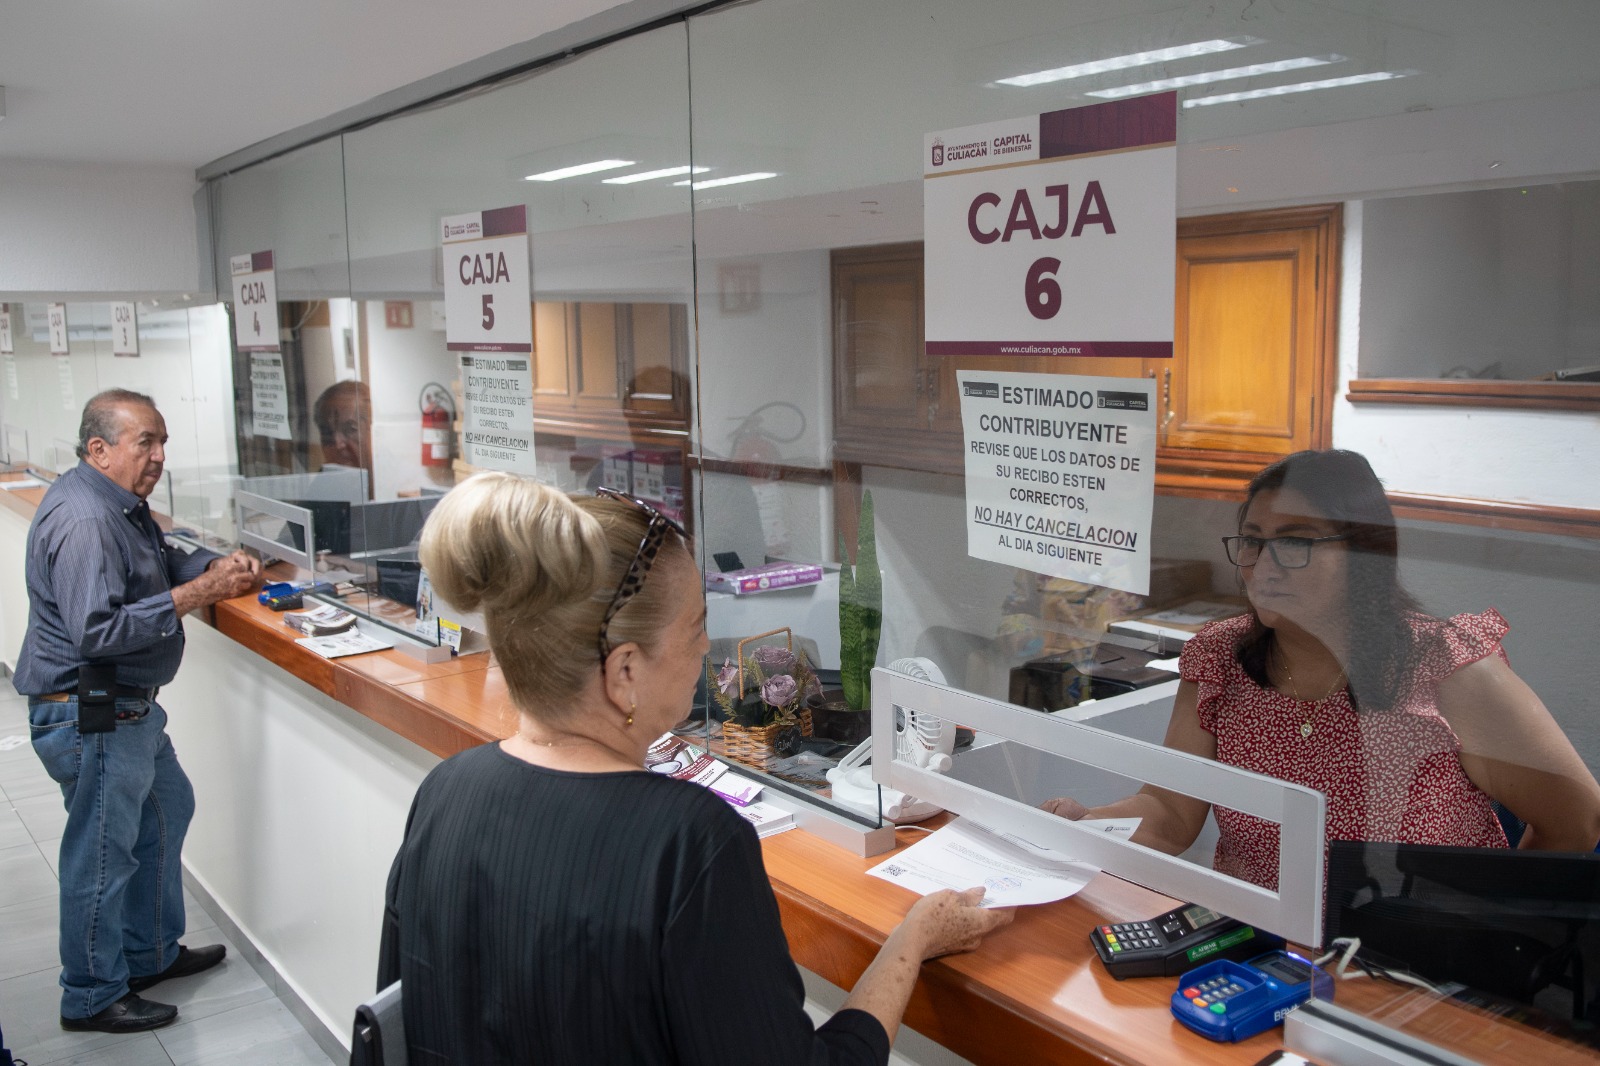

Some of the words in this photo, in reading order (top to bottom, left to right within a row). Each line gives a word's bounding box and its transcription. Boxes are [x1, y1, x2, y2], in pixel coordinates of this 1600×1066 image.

[948, 142, 980, 152] AYUNTAMIENTO
[994, 134, 1032, 147] CAPITAL
[1002, 144, 1032, 154] BIENESTAR
[968, 180, 1116, 244] CAJA
[460, 252, 510, 286] CAJA
[242, 282, 266, 306] CAJA
[1024, 256, 1062, 320] 6
[116, 306, 130, 322] CAJA
[482, 294, 494, 330] 5
[254, 312, 260, 336] 4
[122, 328, 128, 346] 3
[1000, 345, 1081, 354] www.culiacan.gob.mx
[476, 359, 506, 371] ESTIMADO
[468, 376, 519, 390] CONTRIBUYENTE
[479, 394, 489, 402] QUE
[490, 394, 499, 403] LOS
[500, 396, 516, 405] DATOS
[518, 398, 526, 406] DE
[1002, 386, 1094, 409] ESTIMADO
[473, 406, 479, 414] SU
[480, 407, 497, 416] RECIBO
[499, 409, 514, 418] ESTEN
[479, 420, 509, 430] CORRECTOS,
[980, 414, 1128, 444] CONTRIBUYENTE
[466, 432, 473, 440] NO
[474, 434, 485, 442] HAY
[486, 435, 528, 449] CANCELACION
[475, 448, 481, 456] AL
[490, 450, 516, 461] SIGUIENTE
[971, 440, 1010, 457] REVISE
[1013, 446, 1038, 460] QUE
[1041, 450, 1066, 464] LOS
[1070, 452, 1116, 469] DATOS
[1120, 456, 1140, 472] DE
[996, 464, 1010, 478] SU
[1014, 467, 1059, 485] RECIBO
[1063, 473, 1105, 491] ESTEN
[1010, 488, 1089, 514] CORRECTOS,
[974, 506, 992, 522] NO
[996, 510, 1022, 528] HAY
[1026, 516, 1137, 548] CANCELACION
[999, 534, 1012, 549] AL
[1015, 538, 1034, 552] DIA
[1037, 542, 1102, 566] SIGUIENTE
